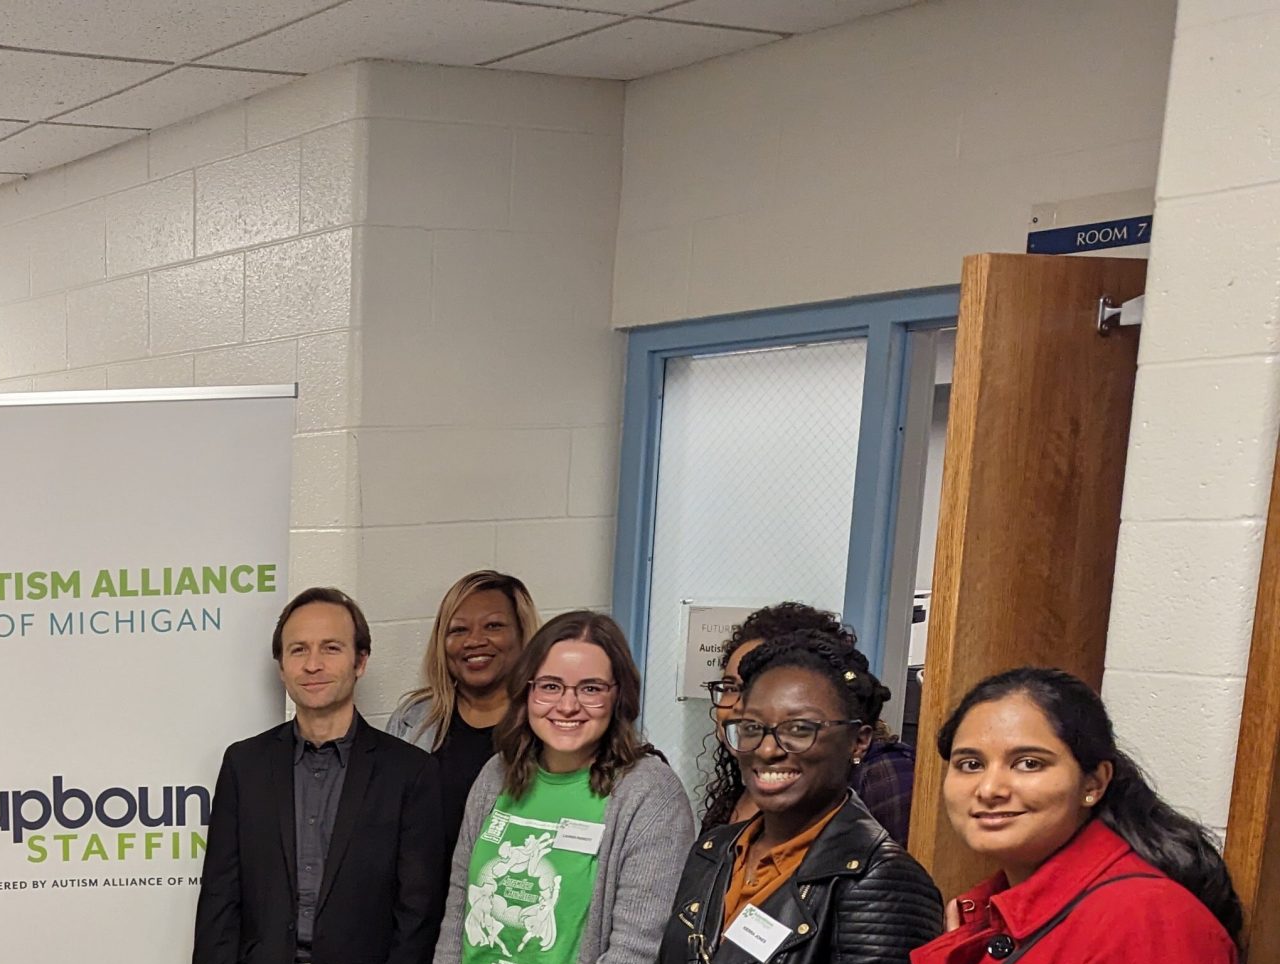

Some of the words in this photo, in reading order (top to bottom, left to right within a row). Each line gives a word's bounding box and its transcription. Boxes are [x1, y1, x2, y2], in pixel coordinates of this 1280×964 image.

[1076, 226, 1128, 246] ROOM
[1137, 223, 1148, 237] 7
[91, 564, 277, 598] ALLIANCE
[50, 607, 222, 636] MICHIGAN
[701, 624, 735, 633] FUTUR
[699, 643, 724, 653] Autis
[706, 658, 716, 667] of
[27, 831, 207, 864] STAFFIN
[32, 879, 47, 889] BY
[51, 878, 99, 889] AUTISM
[103, 877, 163, 887] ALLIANCE
[167, 876, 184, 886] OF
